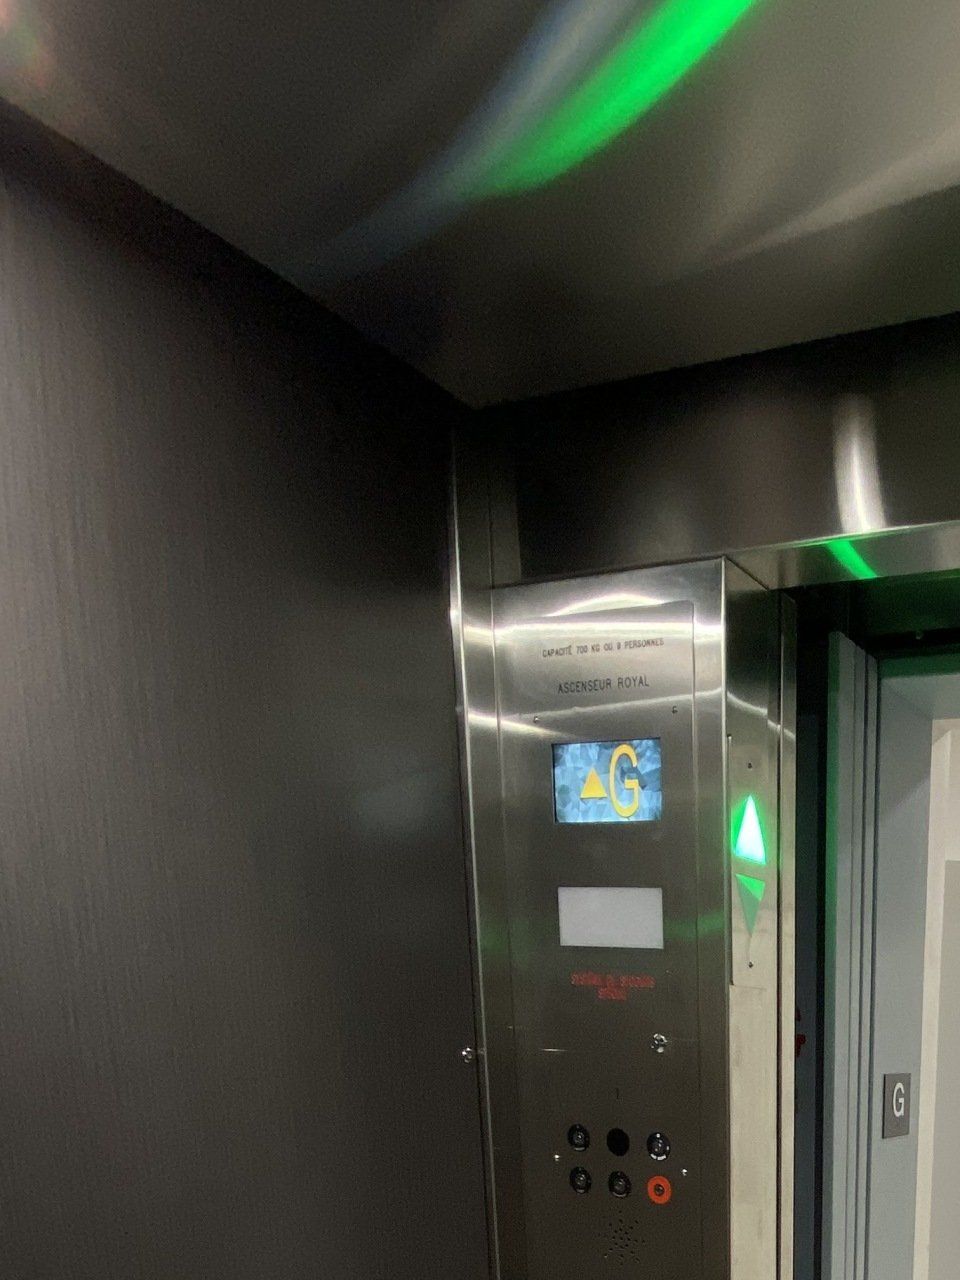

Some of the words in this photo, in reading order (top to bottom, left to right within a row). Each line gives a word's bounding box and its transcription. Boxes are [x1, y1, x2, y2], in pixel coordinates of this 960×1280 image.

[576, 645, 589, 655] 700
[591, 643, 600, 653] KG
[603, 642, 613, 651] OU
[624, 638, 664, 650] PERSONNES
[557, 678, 612, 694] ASCENSEUR
[617, 674, 650, 689] ROYAL
[609, 743, 640, 818] G
[893, 1082, 905, 1117] G
